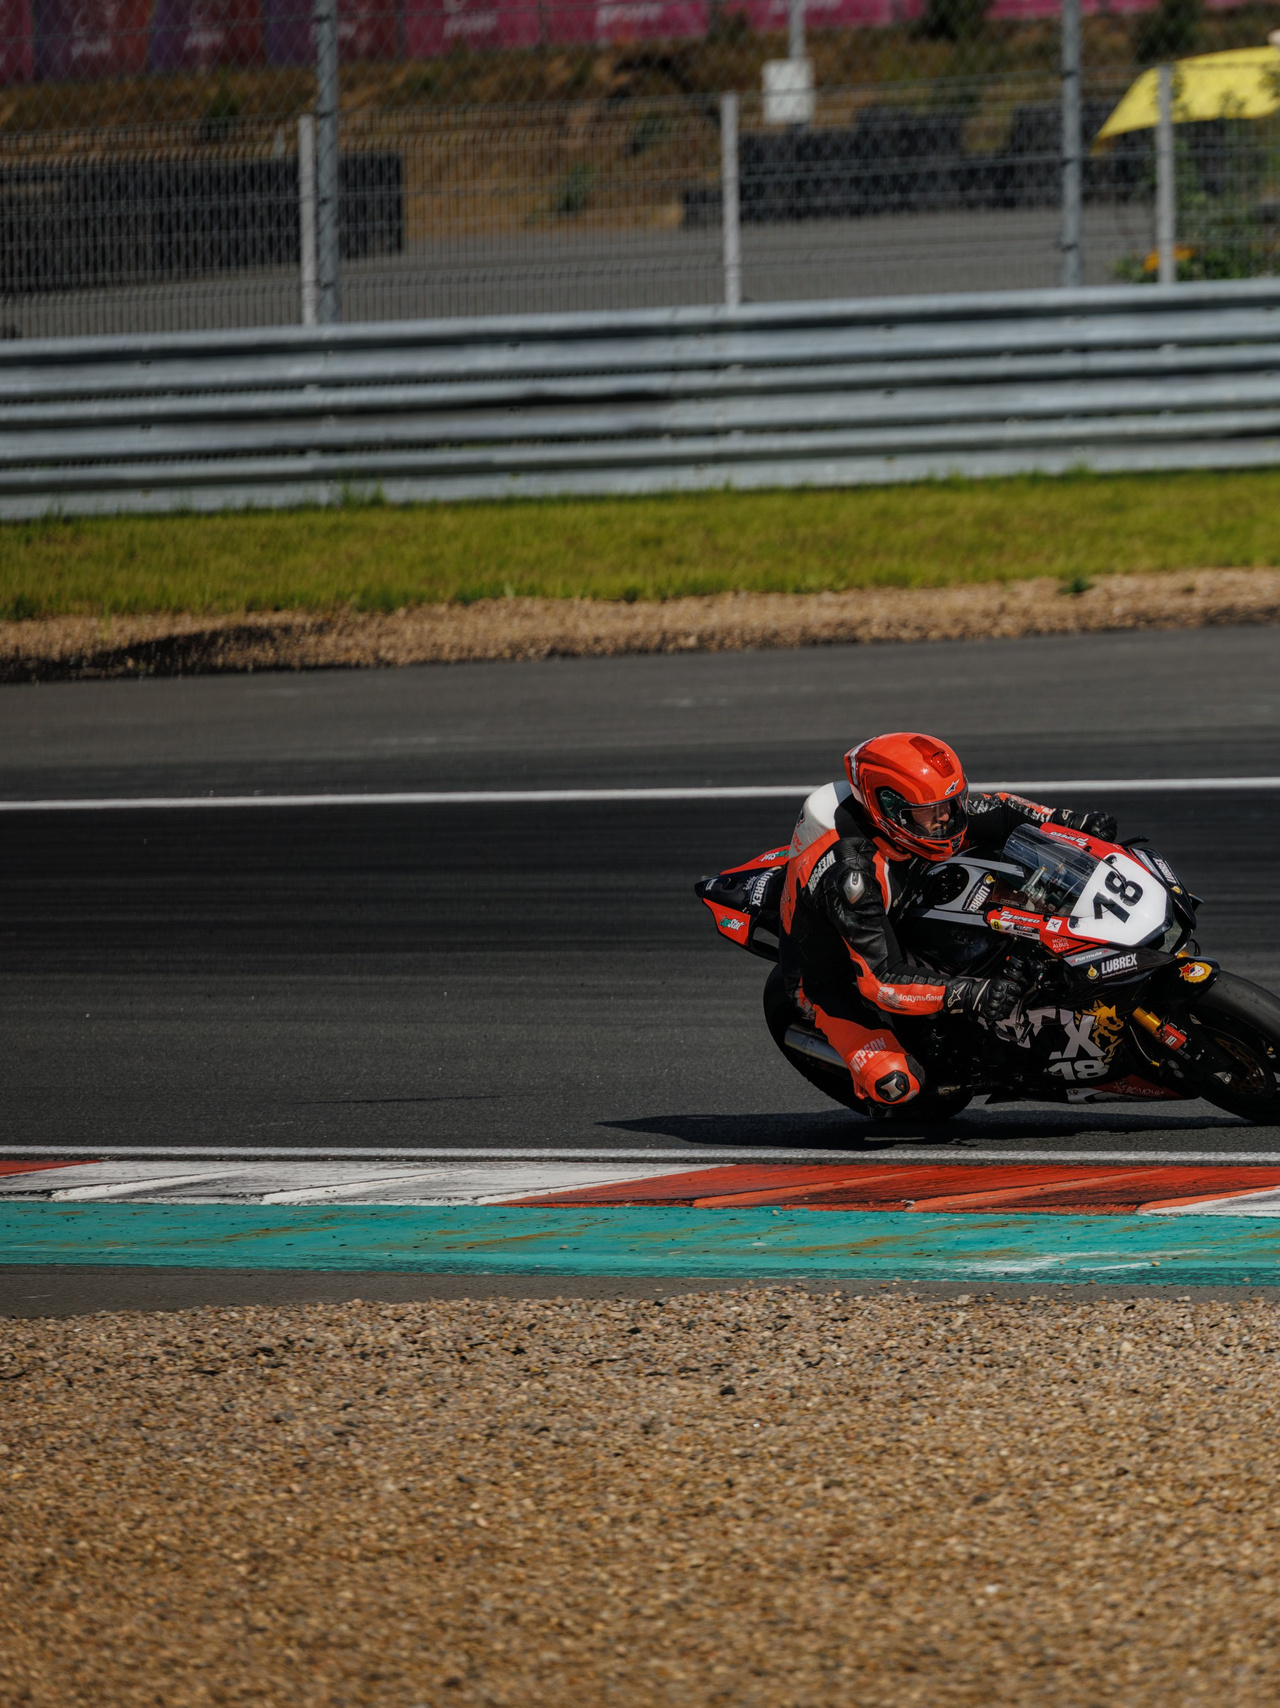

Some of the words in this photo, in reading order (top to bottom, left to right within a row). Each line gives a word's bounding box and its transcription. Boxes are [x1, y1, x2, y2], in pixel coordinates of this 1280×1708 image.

[751, 872, 774, 907] LUBREX
[807, 850, 837, 896] WEPSON
[966, 884, 991, 913] LUBREX
[1092, 870, 1144, 924] 18
[1101, 953, 1138, 974] LUBREX
[849, 1036, 887, 1074] WEPSON
[1048, 1059, 1108, 1081] 18
